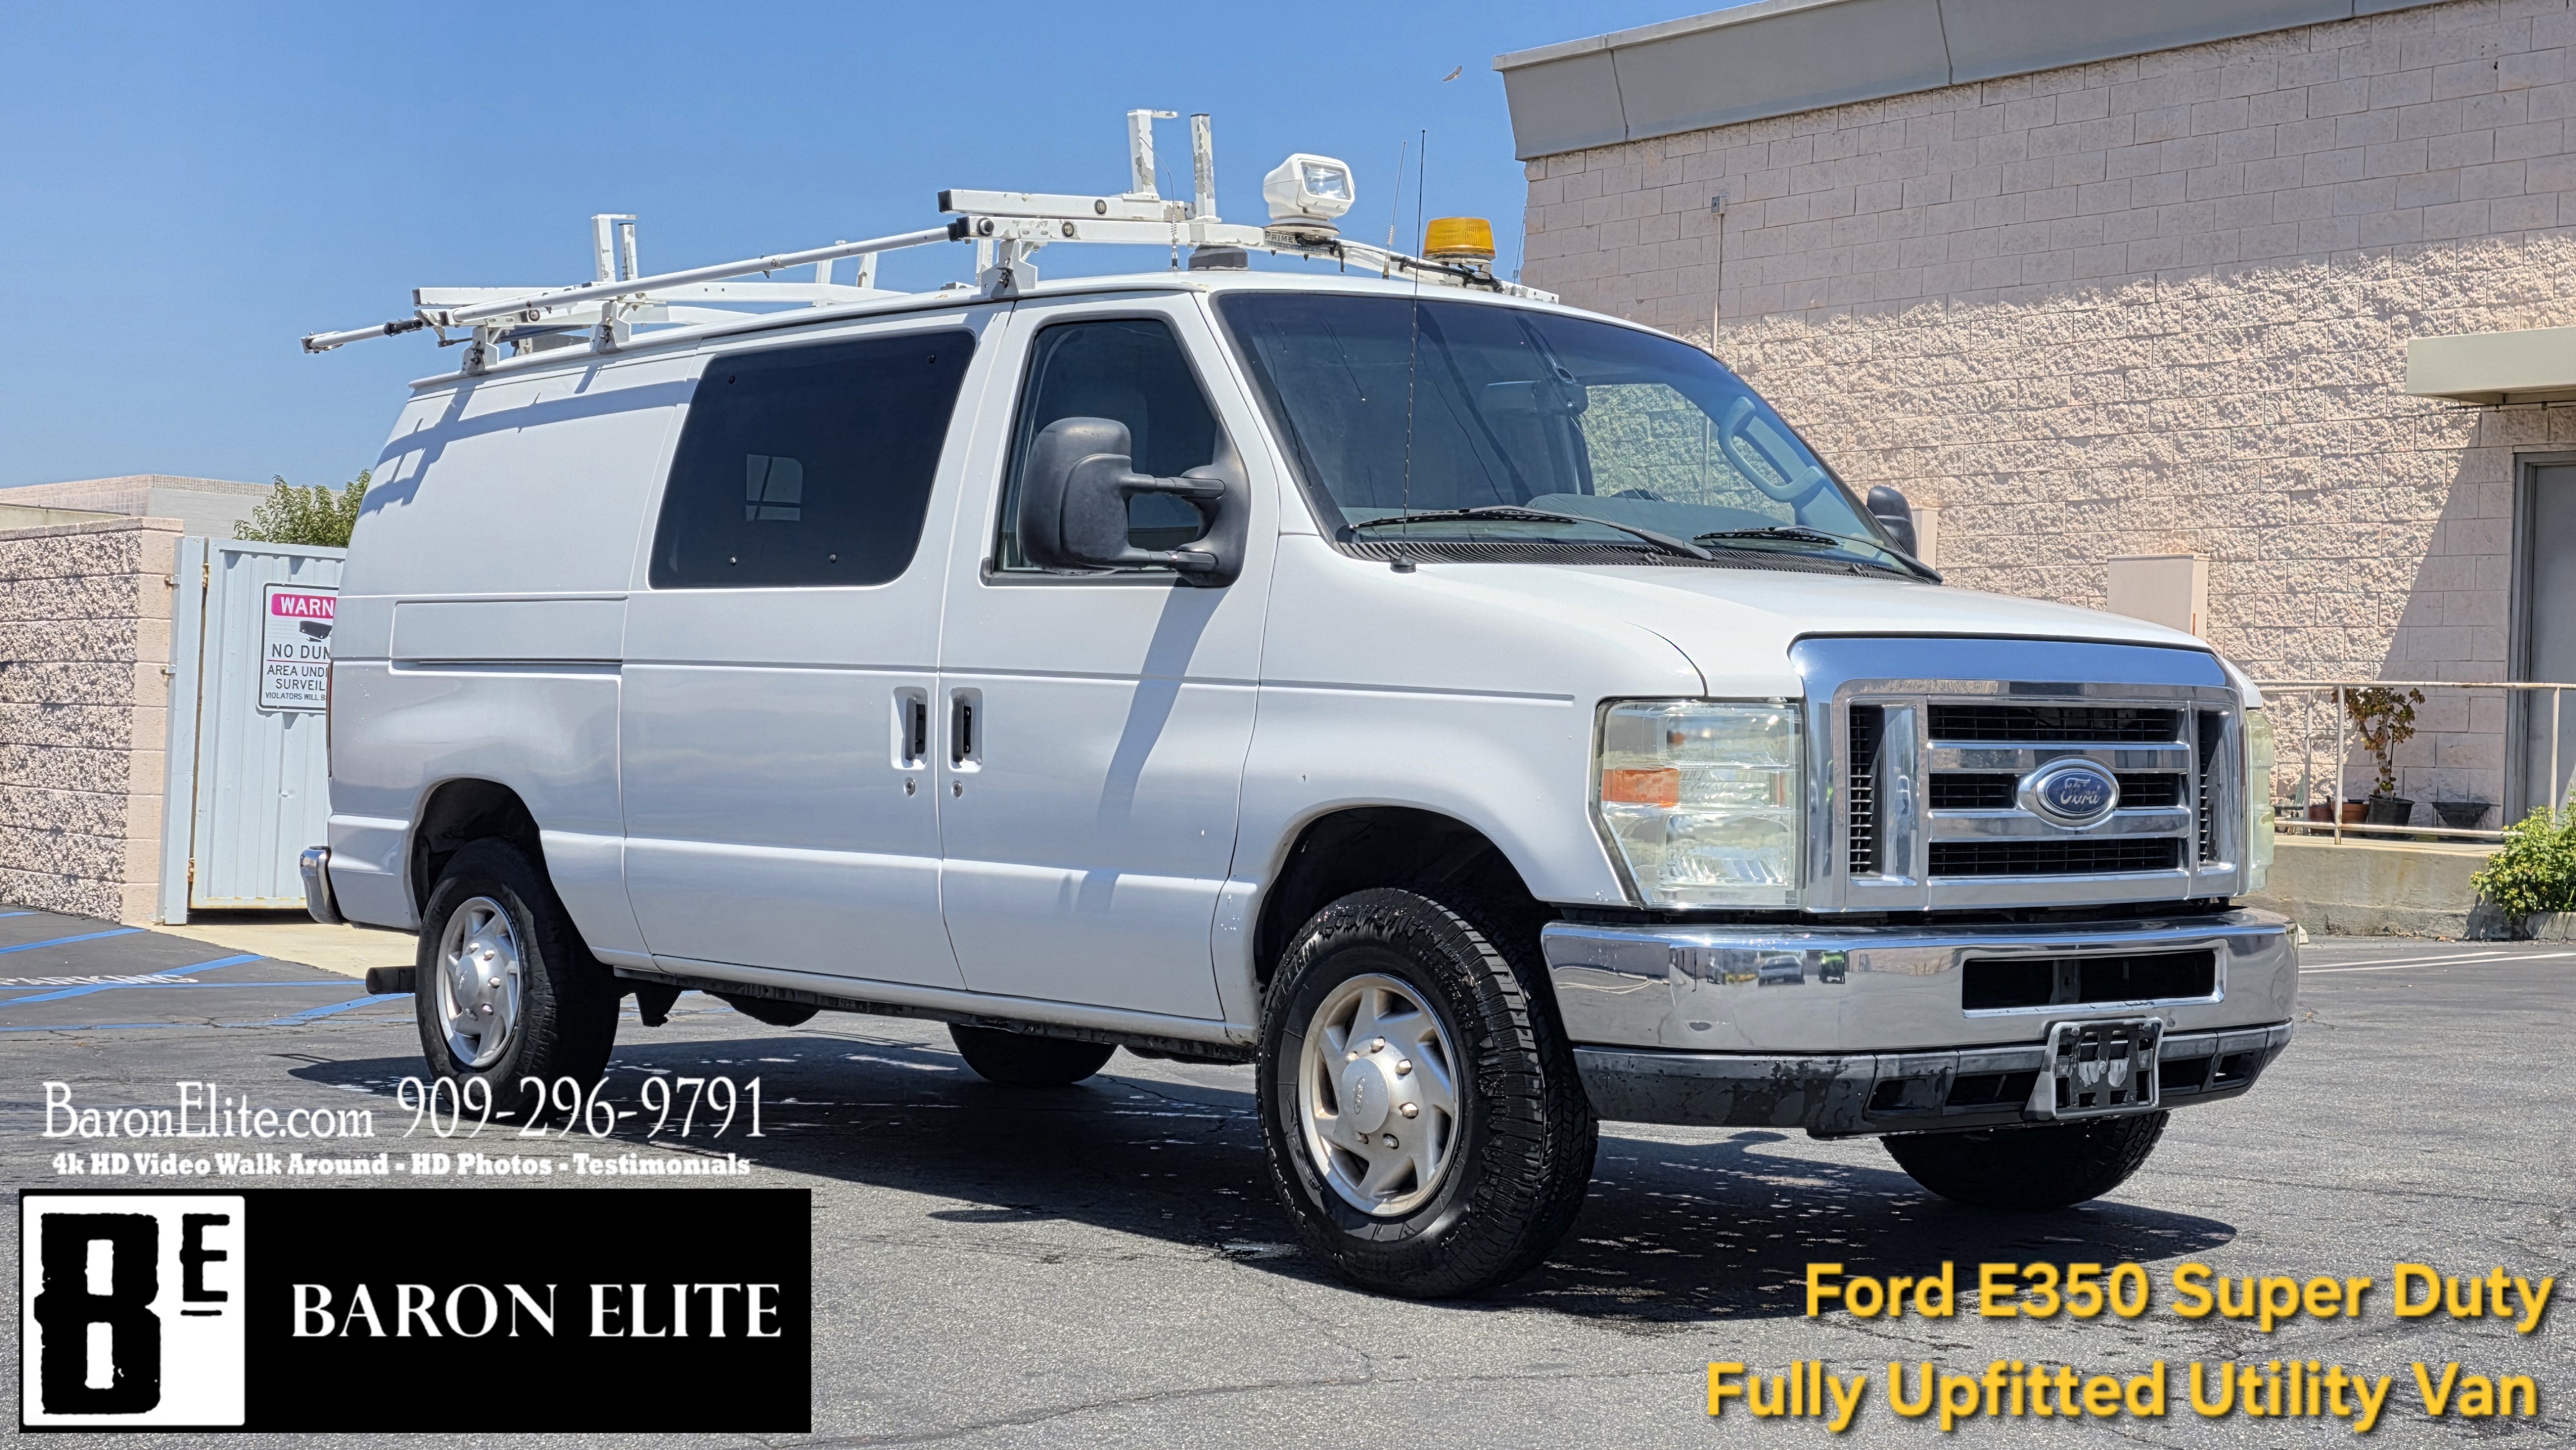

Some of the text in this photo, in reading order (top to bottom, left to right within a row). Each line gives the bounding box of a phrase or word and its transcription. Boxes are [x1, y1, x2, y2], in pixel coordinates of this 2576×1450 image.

[281, 596, 334, 616] WARN
[272, 644, 293, 657] NO
[267, 664, 328, 677] AREA UND
[276, 679, 326, 691] SURVEIL
[265, 692, 303, 700] VIOLATORS
